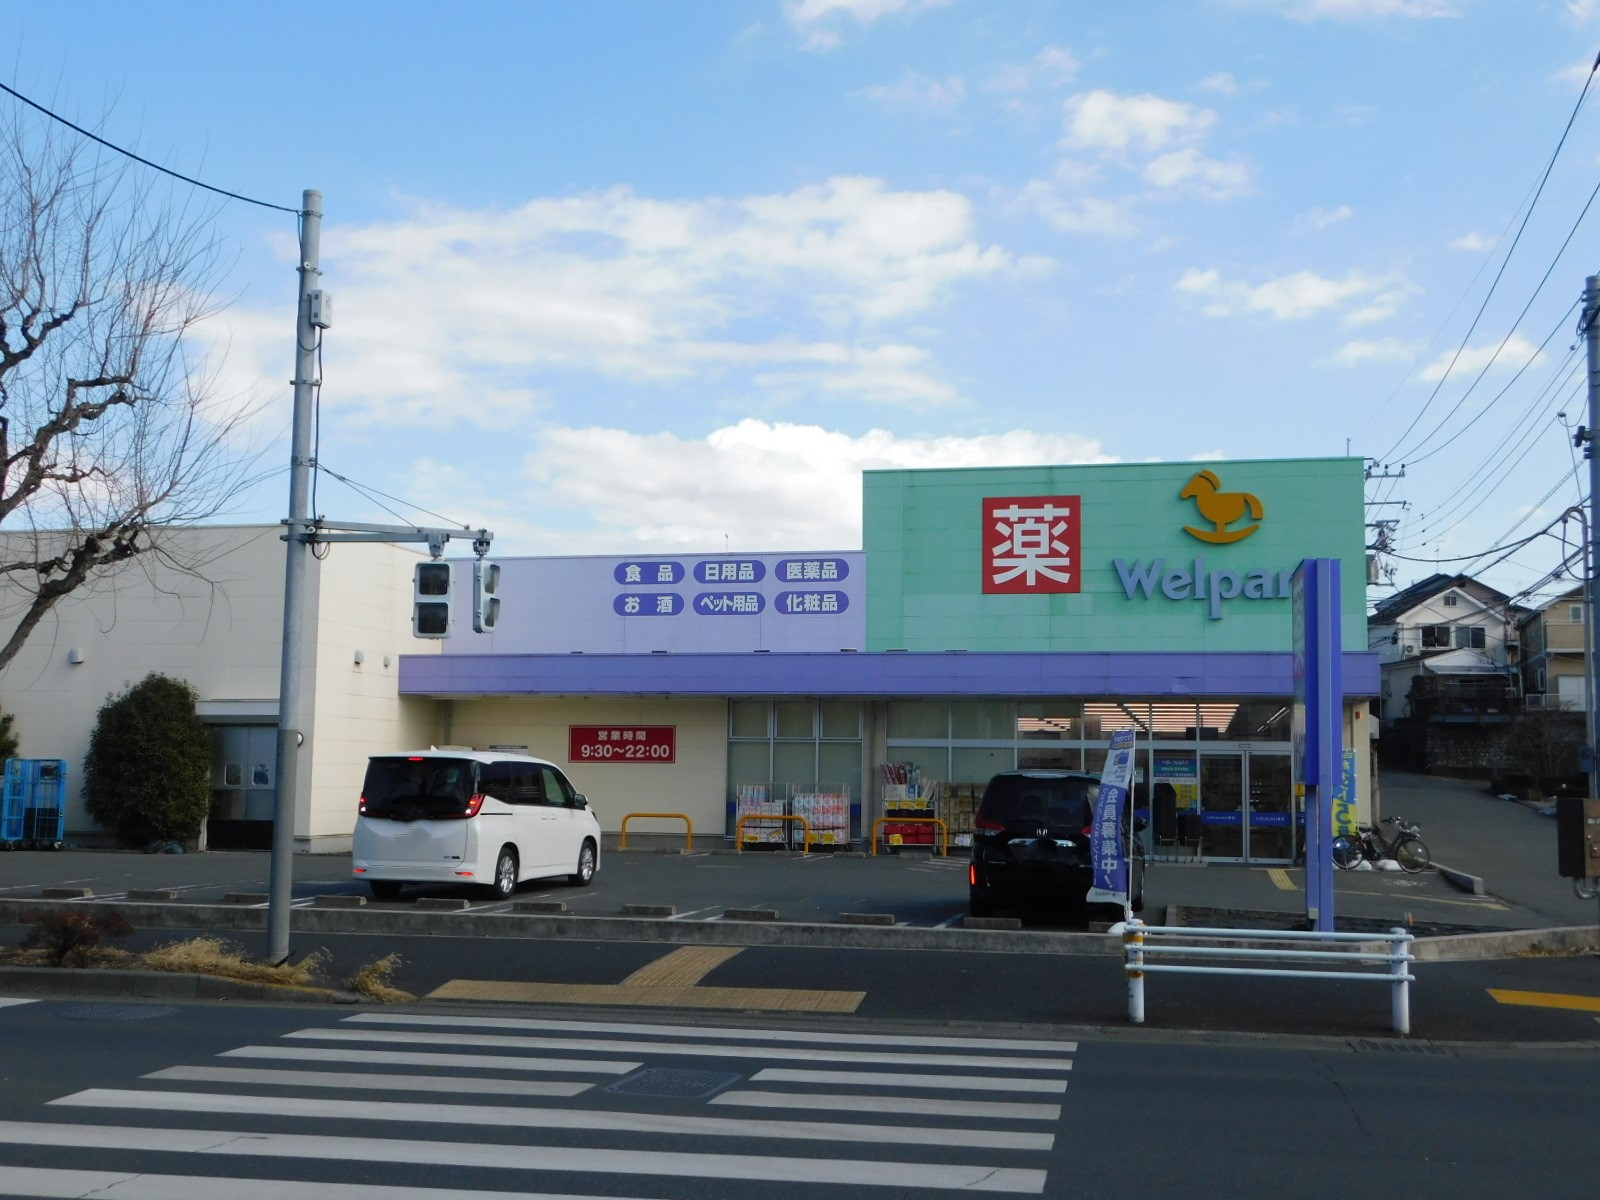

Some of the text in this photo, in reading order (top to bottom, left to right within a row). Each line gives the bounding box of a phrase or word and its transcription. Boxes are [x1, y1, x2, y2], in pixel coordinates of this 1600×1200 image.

[991, 503, 1072, 587] 薬
[625, 564, 674, 582] 食品
[704, 563, 754, 581] 日用品
[786, 561, 838, 580] 医薬品
[1112, 556, 1293, 620] Welpar
[624, 596, 673, 613] お酒
[700, 594, 759, 612] ペット用品
[786, 594, 838, 612] 化粧品
[597, 730, 647, 741] 営業時間
